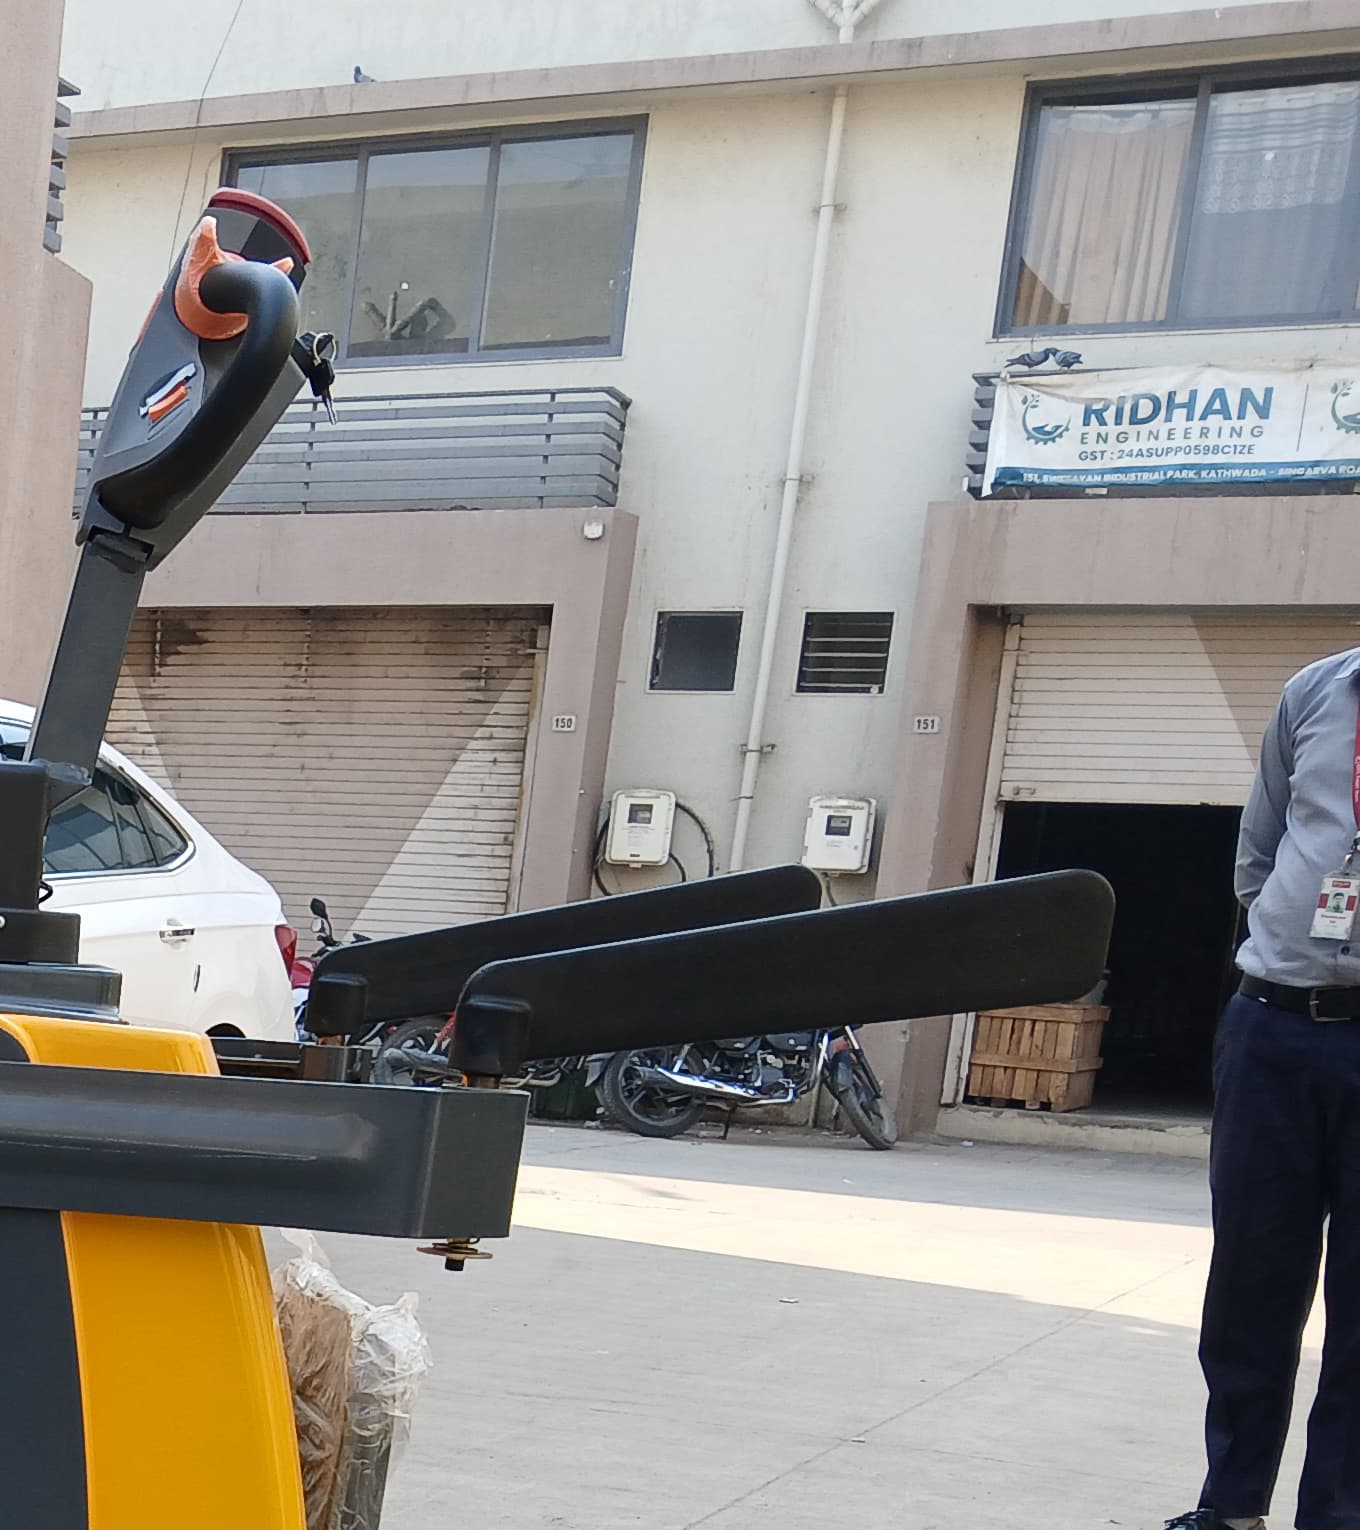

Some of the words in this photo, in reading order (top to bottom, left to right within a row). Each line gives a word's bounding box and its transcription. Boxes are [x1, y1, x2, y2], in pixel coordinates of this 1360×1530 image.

[1082, 387, 1274, 427] RIDHAN
[1080, 425, 1264, 445] ENGINEERING
[1078, 449, 1108, 461] GST
[1200, 468, 1266, 479] KATHWADA
[555, 717, 573, 729] 150
[916, 718, 935, 730] 151
